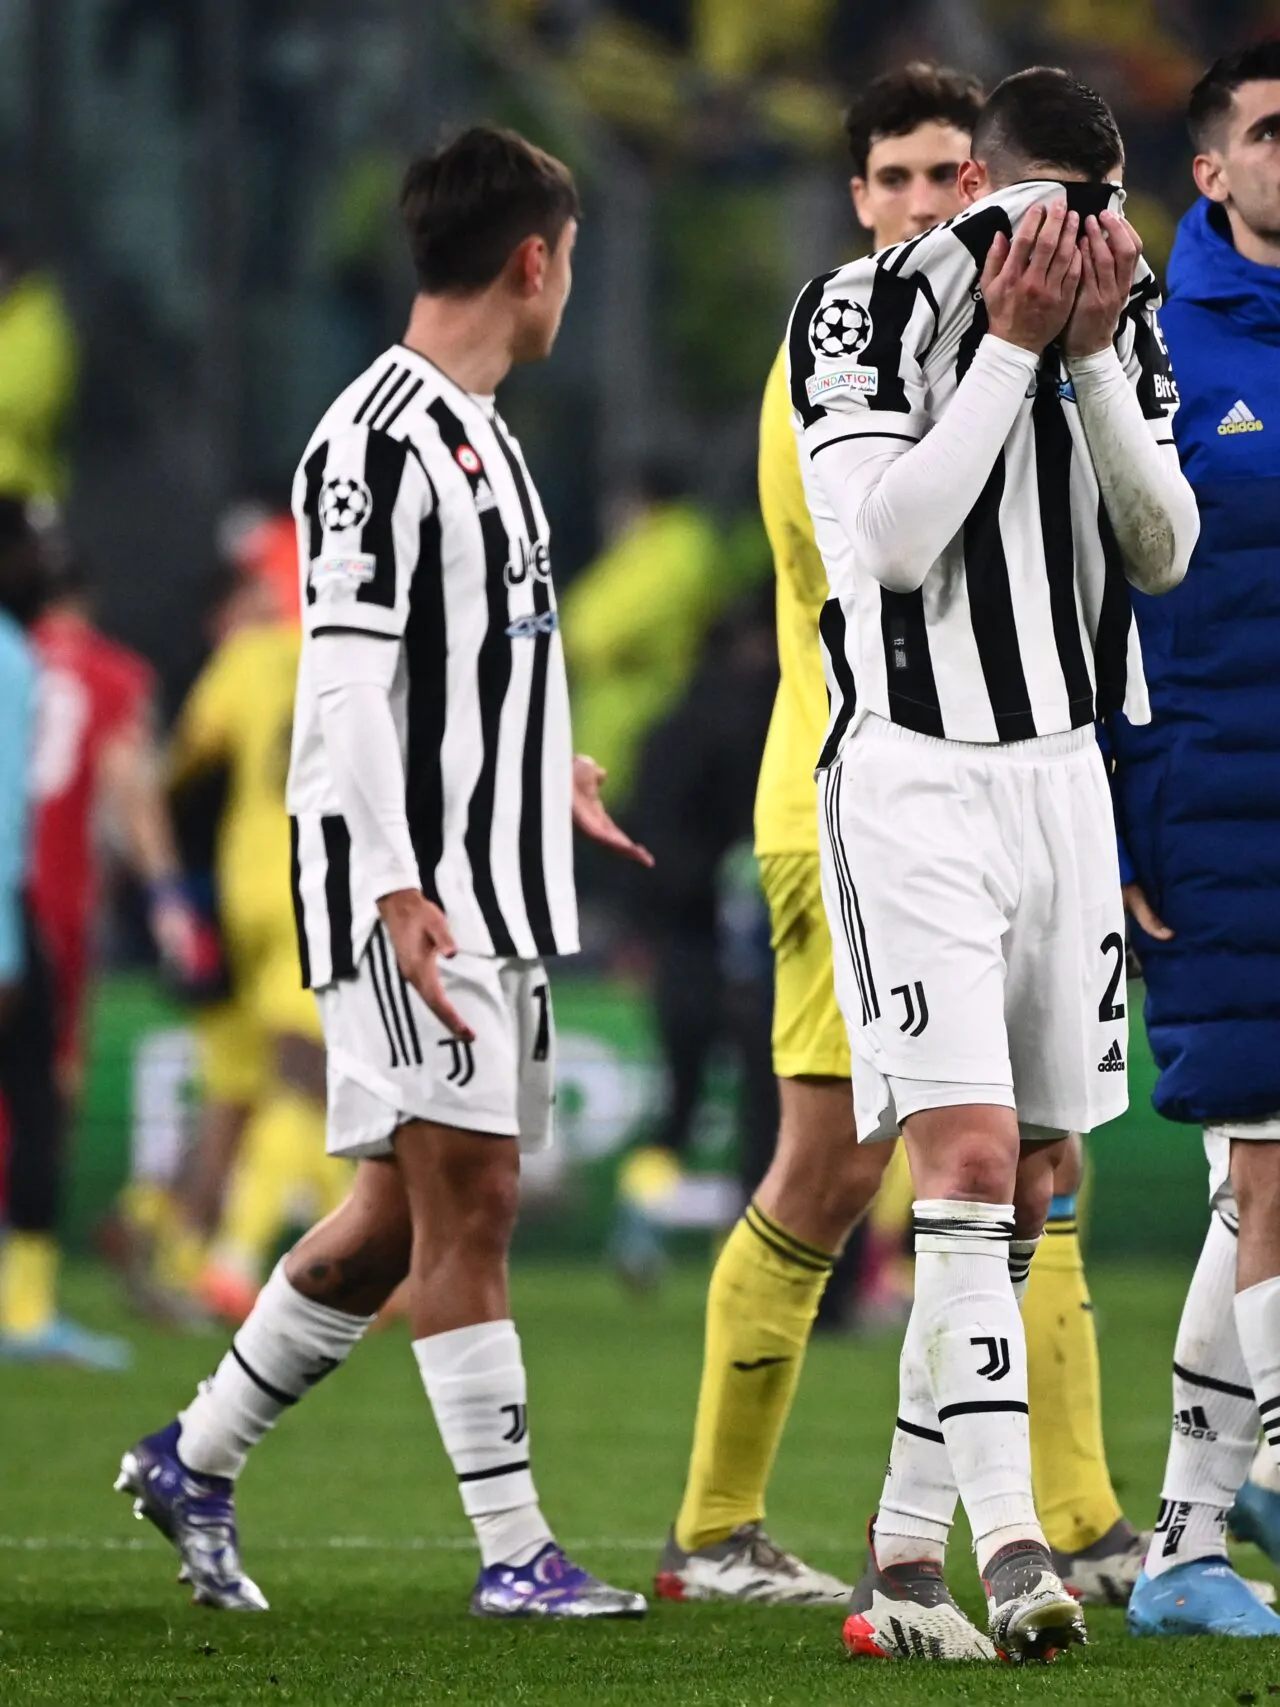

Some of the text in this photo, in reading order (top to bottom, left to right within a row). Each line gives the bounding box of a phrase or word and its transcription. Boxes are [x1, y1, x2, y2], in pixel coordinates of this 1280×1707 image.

[1217, 419, 1264, 436] adidas
[504, 535, 551, 585] Je
[1098, 931, 1125, 1023] 2
